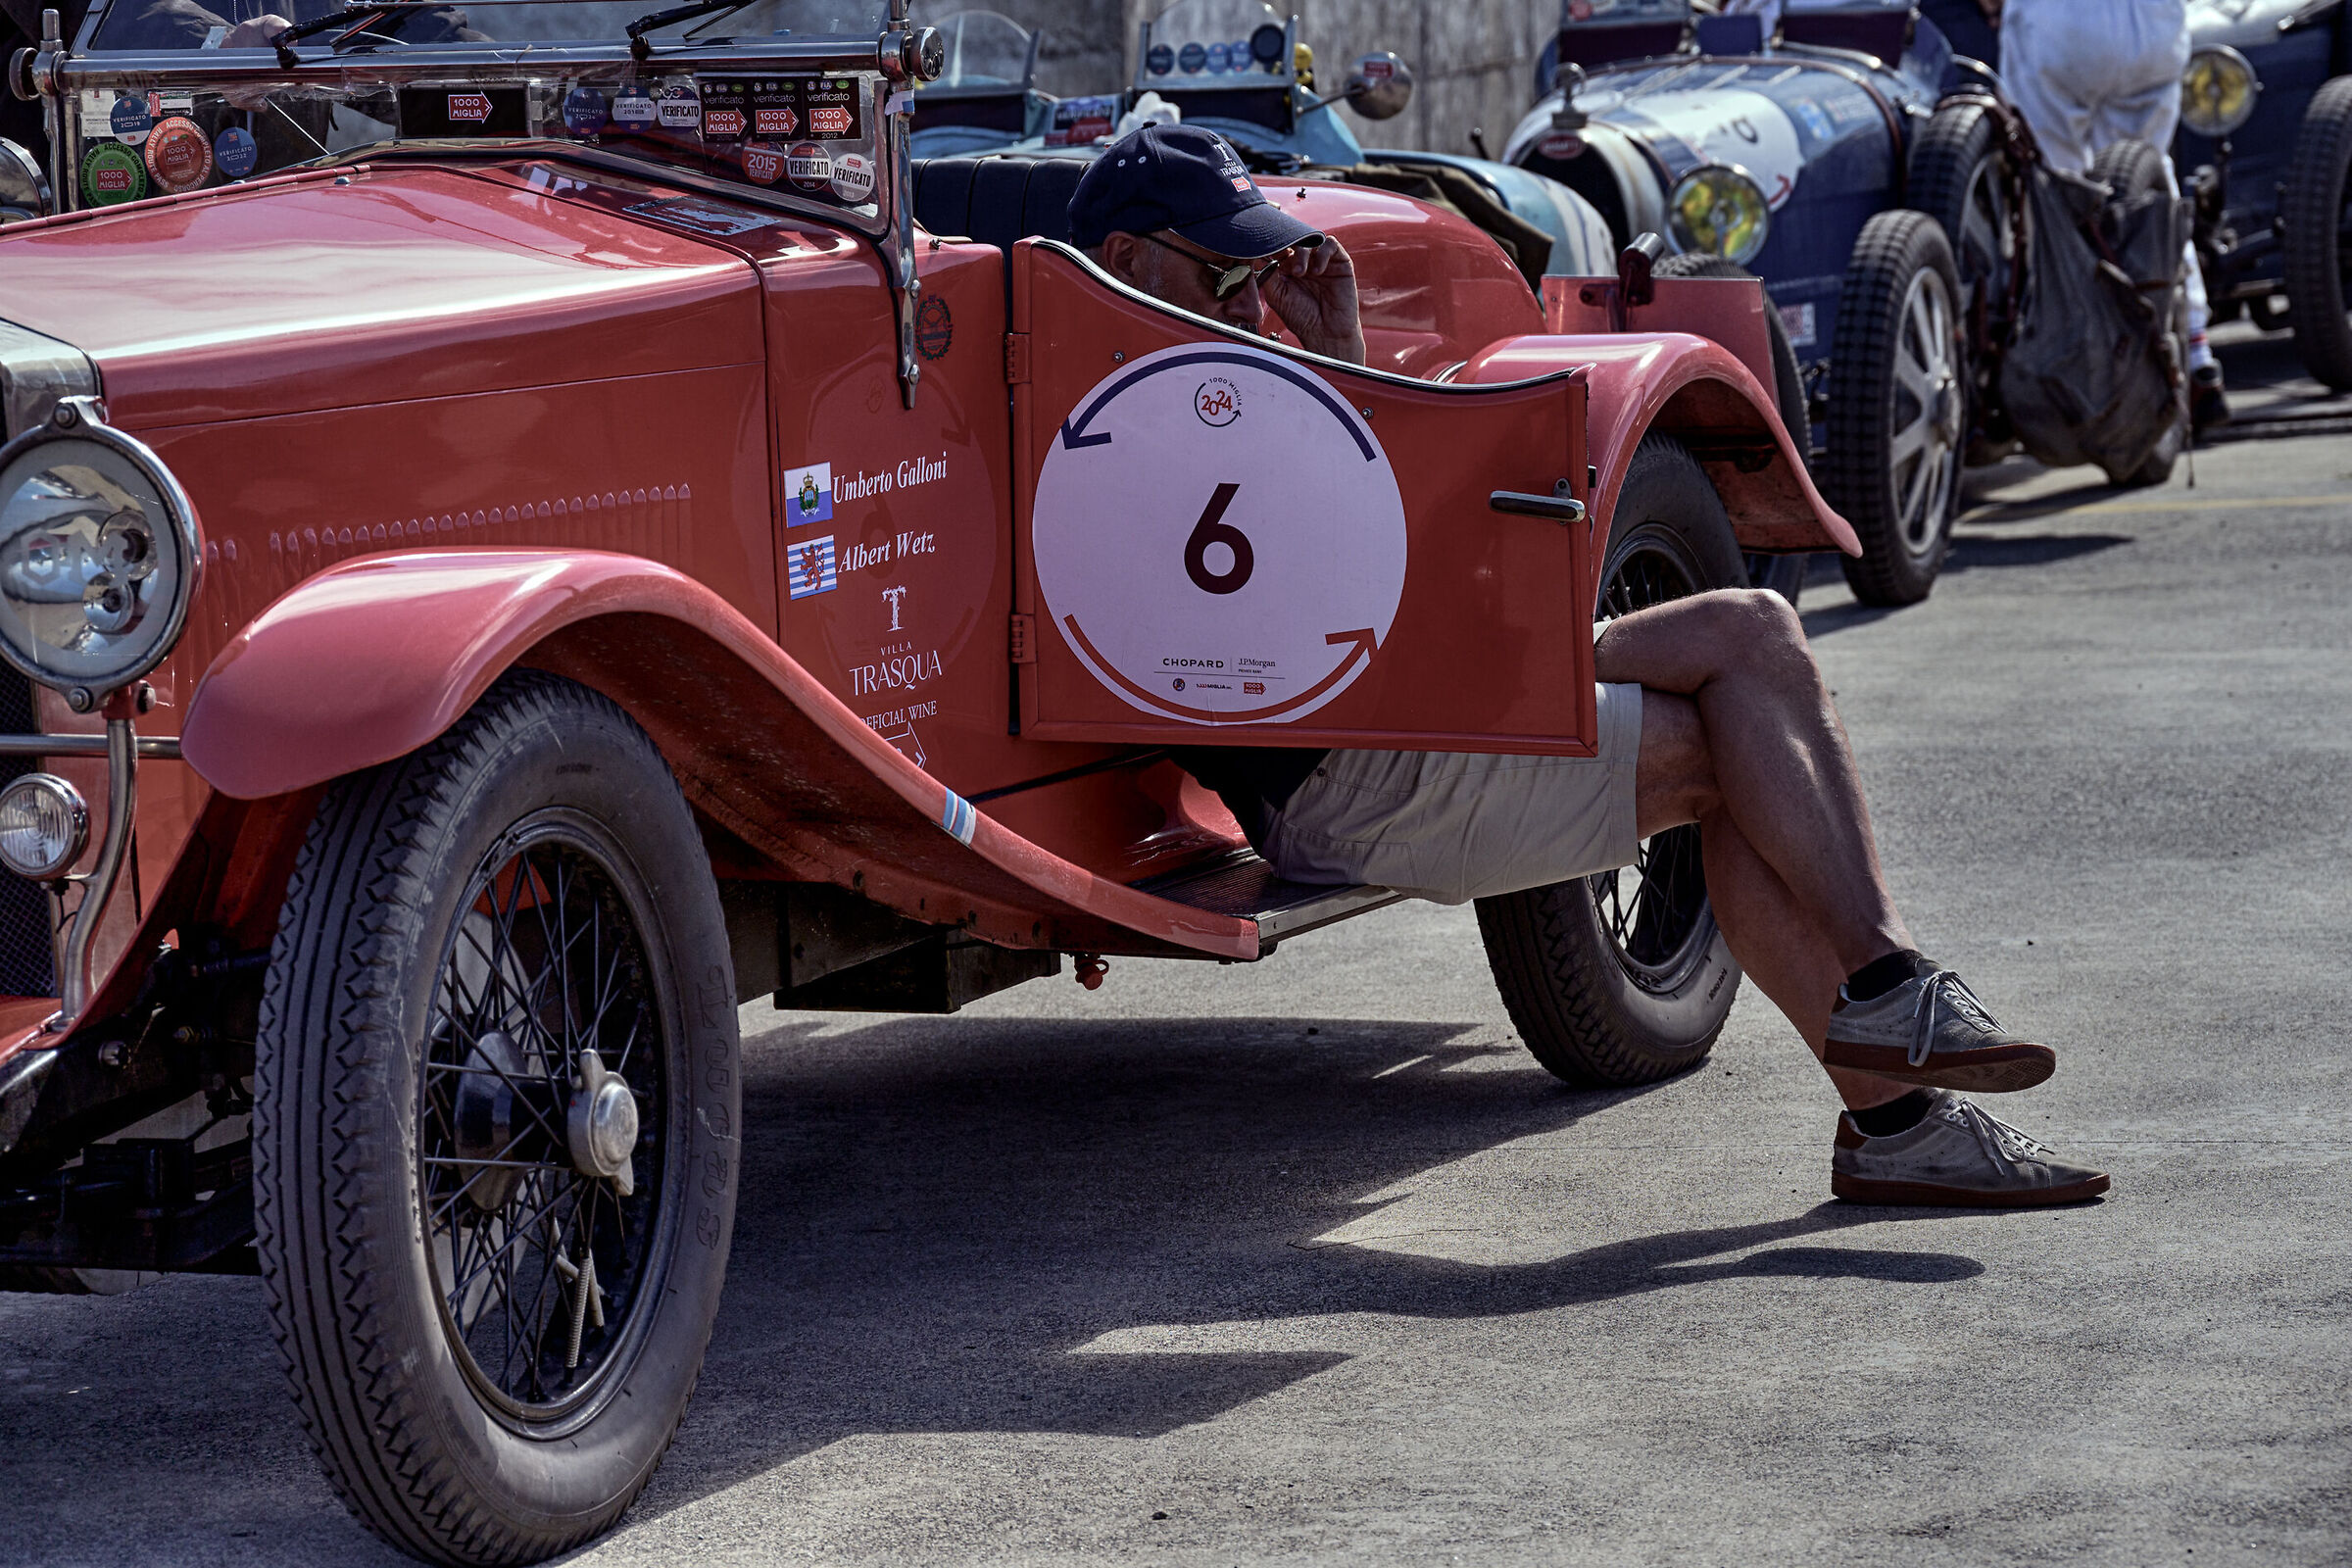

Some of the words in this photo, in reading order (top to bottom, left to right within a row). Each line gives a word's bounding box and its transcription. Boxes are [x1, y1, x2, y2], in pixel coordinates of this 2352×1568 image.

[704, 95, 745, 104] verificato
[754, 93, 796, 103] verificato
[807, 91, 851, 102] verificato
[452, 109, 482, 118] MIGLIA
[661, 105, 700, 118] VERIFICATO
[760, 112, 787, 121] 1000
[813, 111, 841, 120] 1000
[710, 113, 735, 122] 1000
[166, 119, 194, 130] ACCESSO
[709, 122, 738, 131] MIGLIA
[759, 122, 790, 130] MIGLIA
[812, 121, 844, 129] MIGLIA
[150, 127, 164, 148] RALLY
[104, 142, 132, 157] ACCESSO
[167, 145, 186, 154] 1000
[219, 146, 252, 157] VERIFICATO
[84, 148, 100, 169] RALLY
[147, 149, 158, 173] ROUTE
[167, 153, 189, 163] MIGLIA
[747, 154, 777, 172] 2015
[789, 161, 829, 175] VERIFICATO
[100, 171, 123, 179] 1000
[749, 169, 773, 179] VERIFICATO
[833, 167, 871, 187] VERIFICATO
[99, 179, 125, 188] MIGLIA
[155, 172, 170, 188] PASS
[1228, 382, 1243, 407] MIGLIA
[1201, 390, 1233, 416] 2024
[833, 470, 893, 504] Umberto
[897, 451, 948, 488] Galloni
[1184, 482, 1254, 595] 6
[838, 540, 891, 573] Albert
[896, 530, 936, 560] Wetz
[880, 641, 912, 656] VILLA
[1162, 658, 1224, 667] CHOPARD
[849, 650, 942, 696] TRASQUA
[907, 700, 938, 720] WINE
